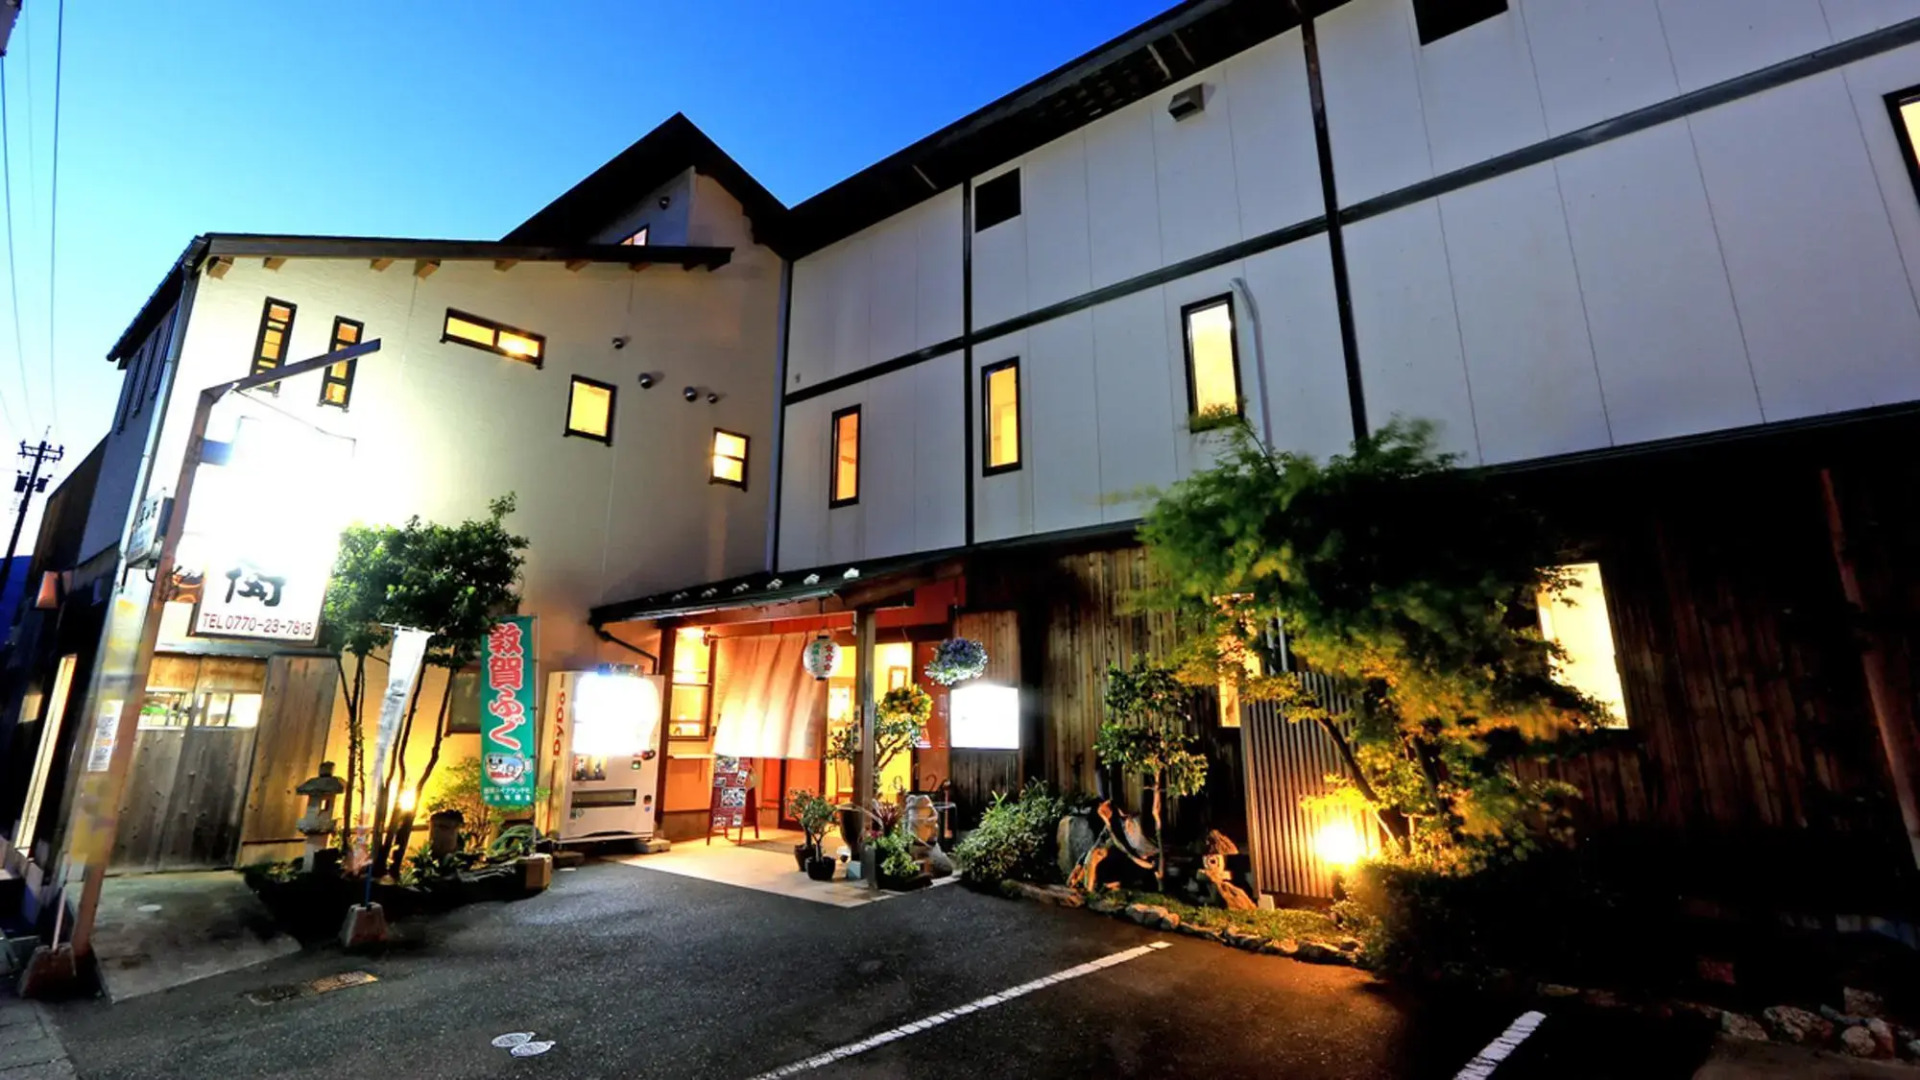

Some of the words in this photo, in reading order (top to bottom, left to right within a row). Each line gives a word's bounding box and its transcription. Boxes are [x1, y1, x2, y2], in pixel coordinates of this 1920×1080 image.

[487, 622, 525, 751] 敦賀ふぐ
[553, 692, 566, 756] DyDo
